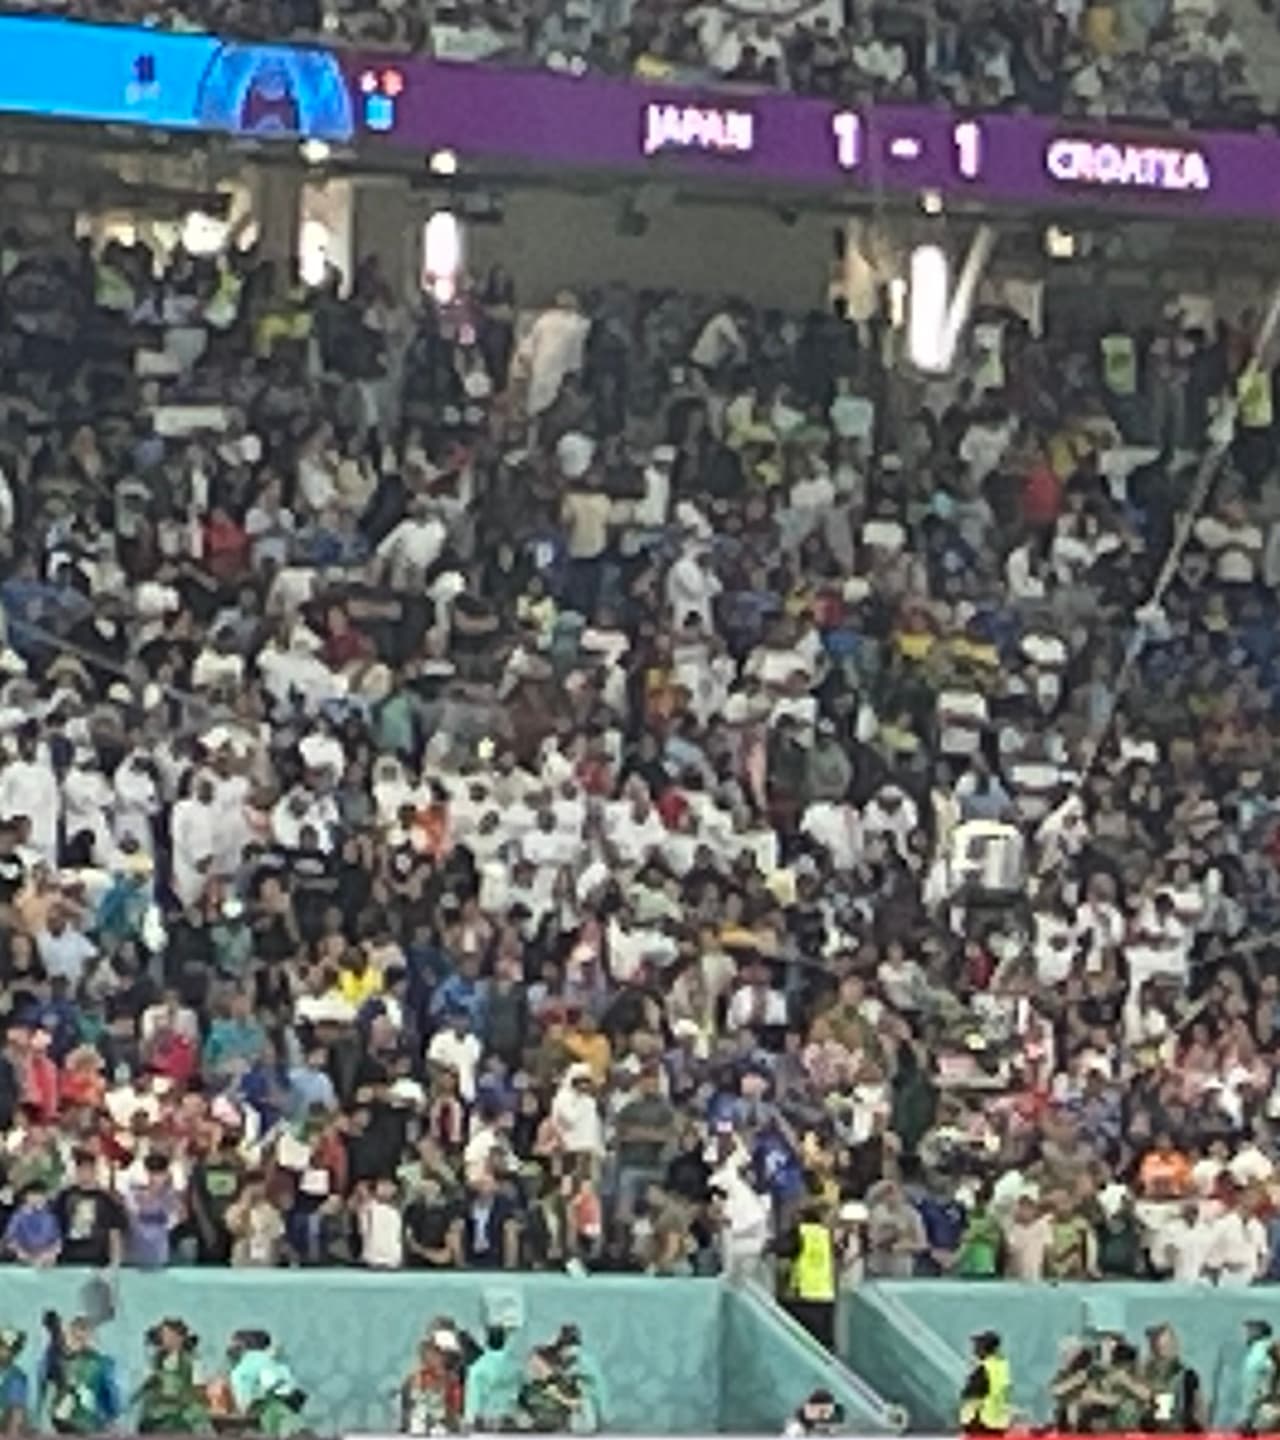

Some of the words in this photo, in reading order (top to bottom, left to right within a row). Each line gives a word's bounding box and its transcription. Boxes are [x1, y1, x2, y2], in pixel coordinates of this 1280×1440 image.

[644, 103, 753, 155] JAPAN
[832, 111, 860, 168] 1
[954, 121, 980, 178] 1
[1047, 139, 1211, 190] CROATIA
